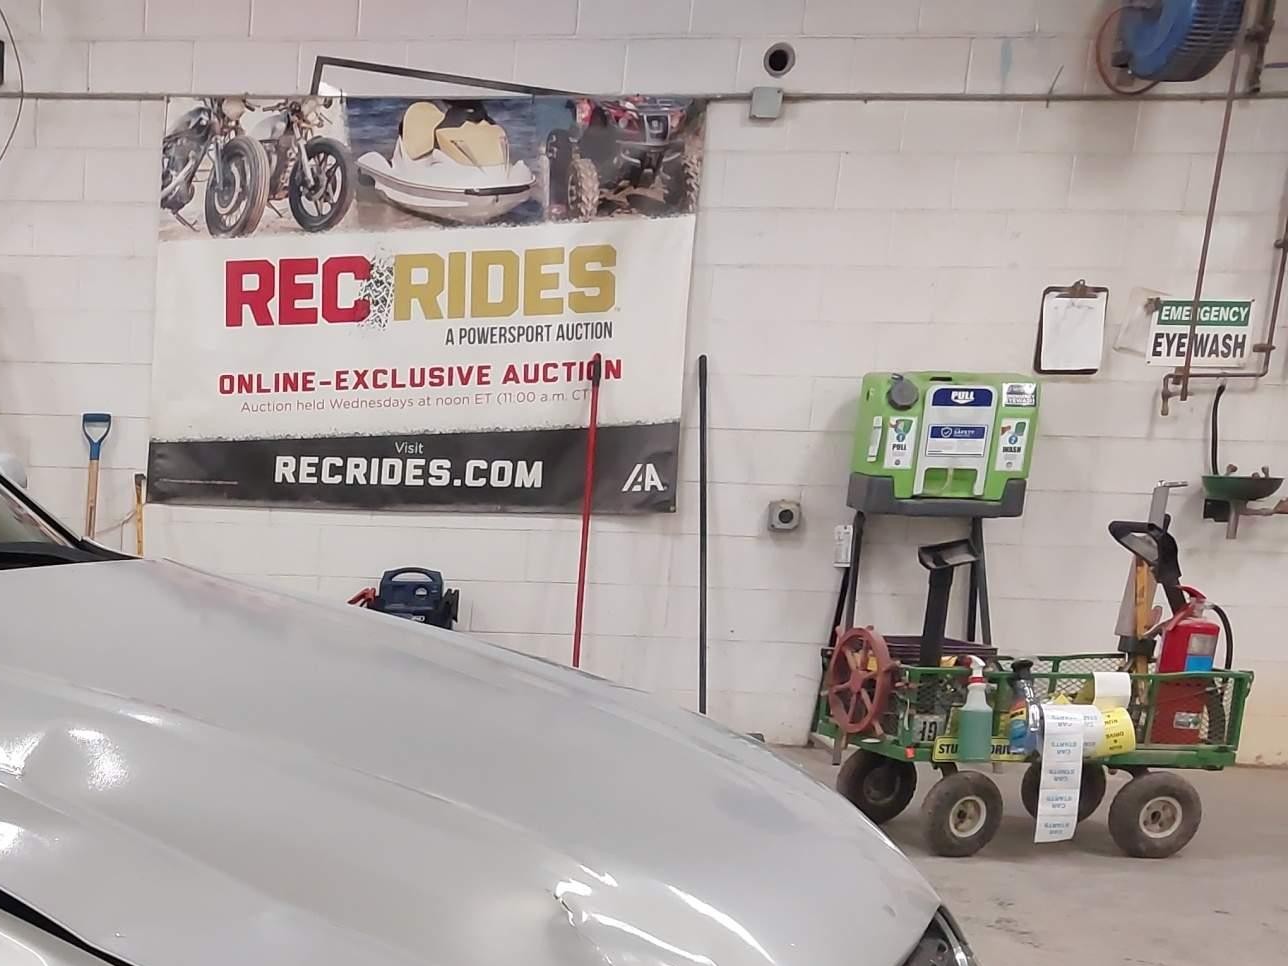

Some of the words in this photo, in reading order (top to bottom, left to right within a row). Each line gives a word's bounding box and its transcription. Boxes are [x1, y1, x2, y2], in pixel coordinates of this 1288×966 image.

[225, 254, 373, 328] REC
[392, 243, 617, 322] RIDES
[445, 328, 455, 345] A
[459, 324, 553, 345] POWERSPORT
[556, 321, 613, 341] AUCTION
[1152, 333, 1187, 357] EYE
[1193, 333, 1247, 358] WASH
[218, 365, 492, 395] ONLINE-EXCLUSIVE
[240, 401, 292, 413] Auction
[296, 399, 325, 411] held
[329, 397, 414, 411] Wednesdays
[417, 396, 431, 407] at
[435, 395, 470, 406] noon
[474, 393, 493, 405] ET
[951, 391, 975, 400] PULL
[394, 441, 424, 454] Visit
[273, 455, 544, 488] RECRIDES.COM
